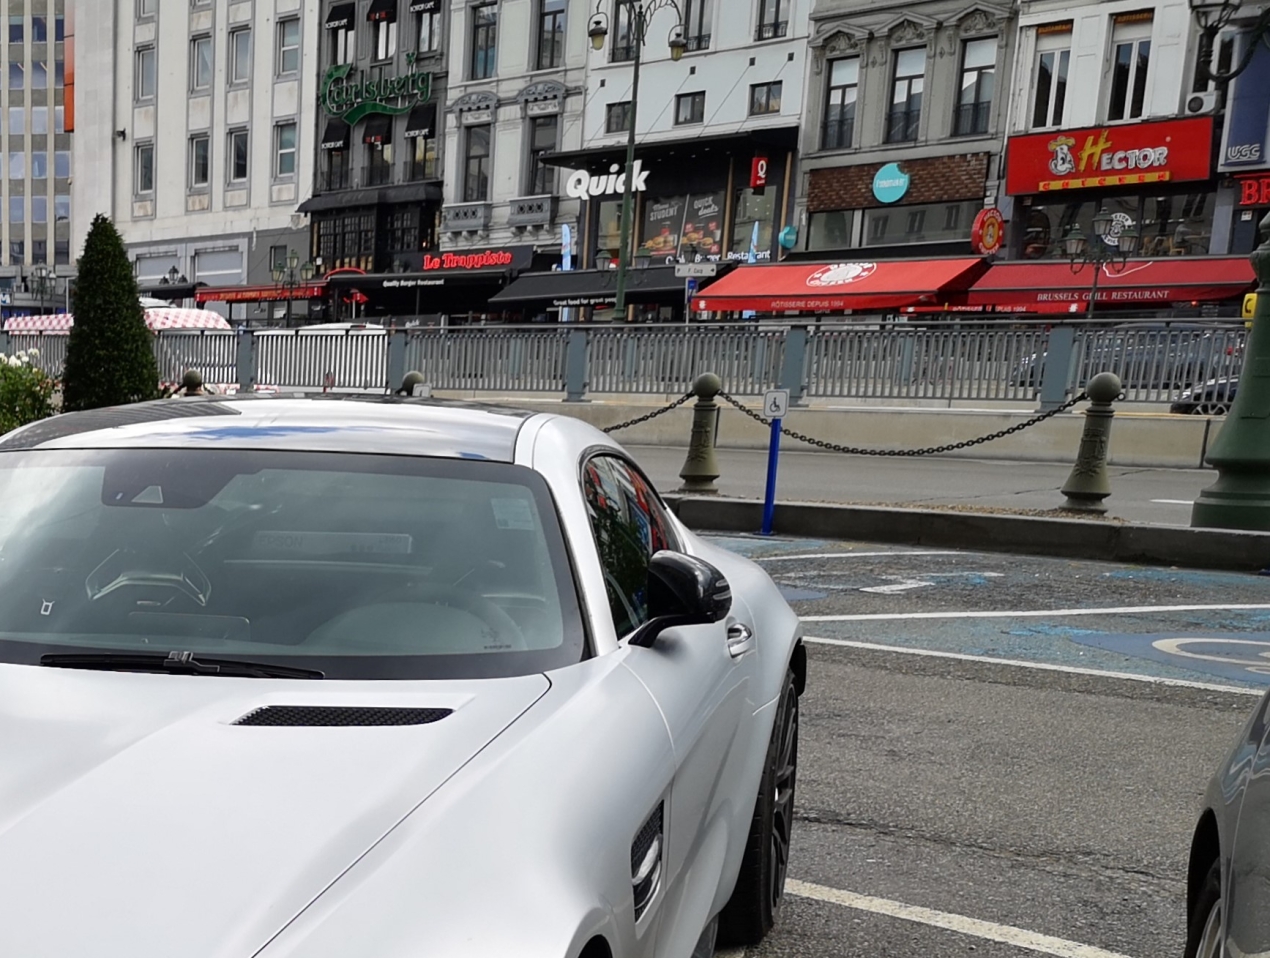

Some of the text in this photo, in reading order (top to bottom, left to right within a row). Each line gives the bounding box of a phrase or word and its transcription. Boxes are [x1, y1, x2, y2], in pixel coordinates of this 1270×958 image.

[320, 60, 433, 122] Carlsberg
[1228, 143, 1261, 160] UGC
[423, 250, 512, 270] Le Trappiste
[1037, 292, 1078, 300] BRUSSELS
[1111, 290, 1170, 299] RESTAURANT
[259, 535, 303, 548] EPSON
